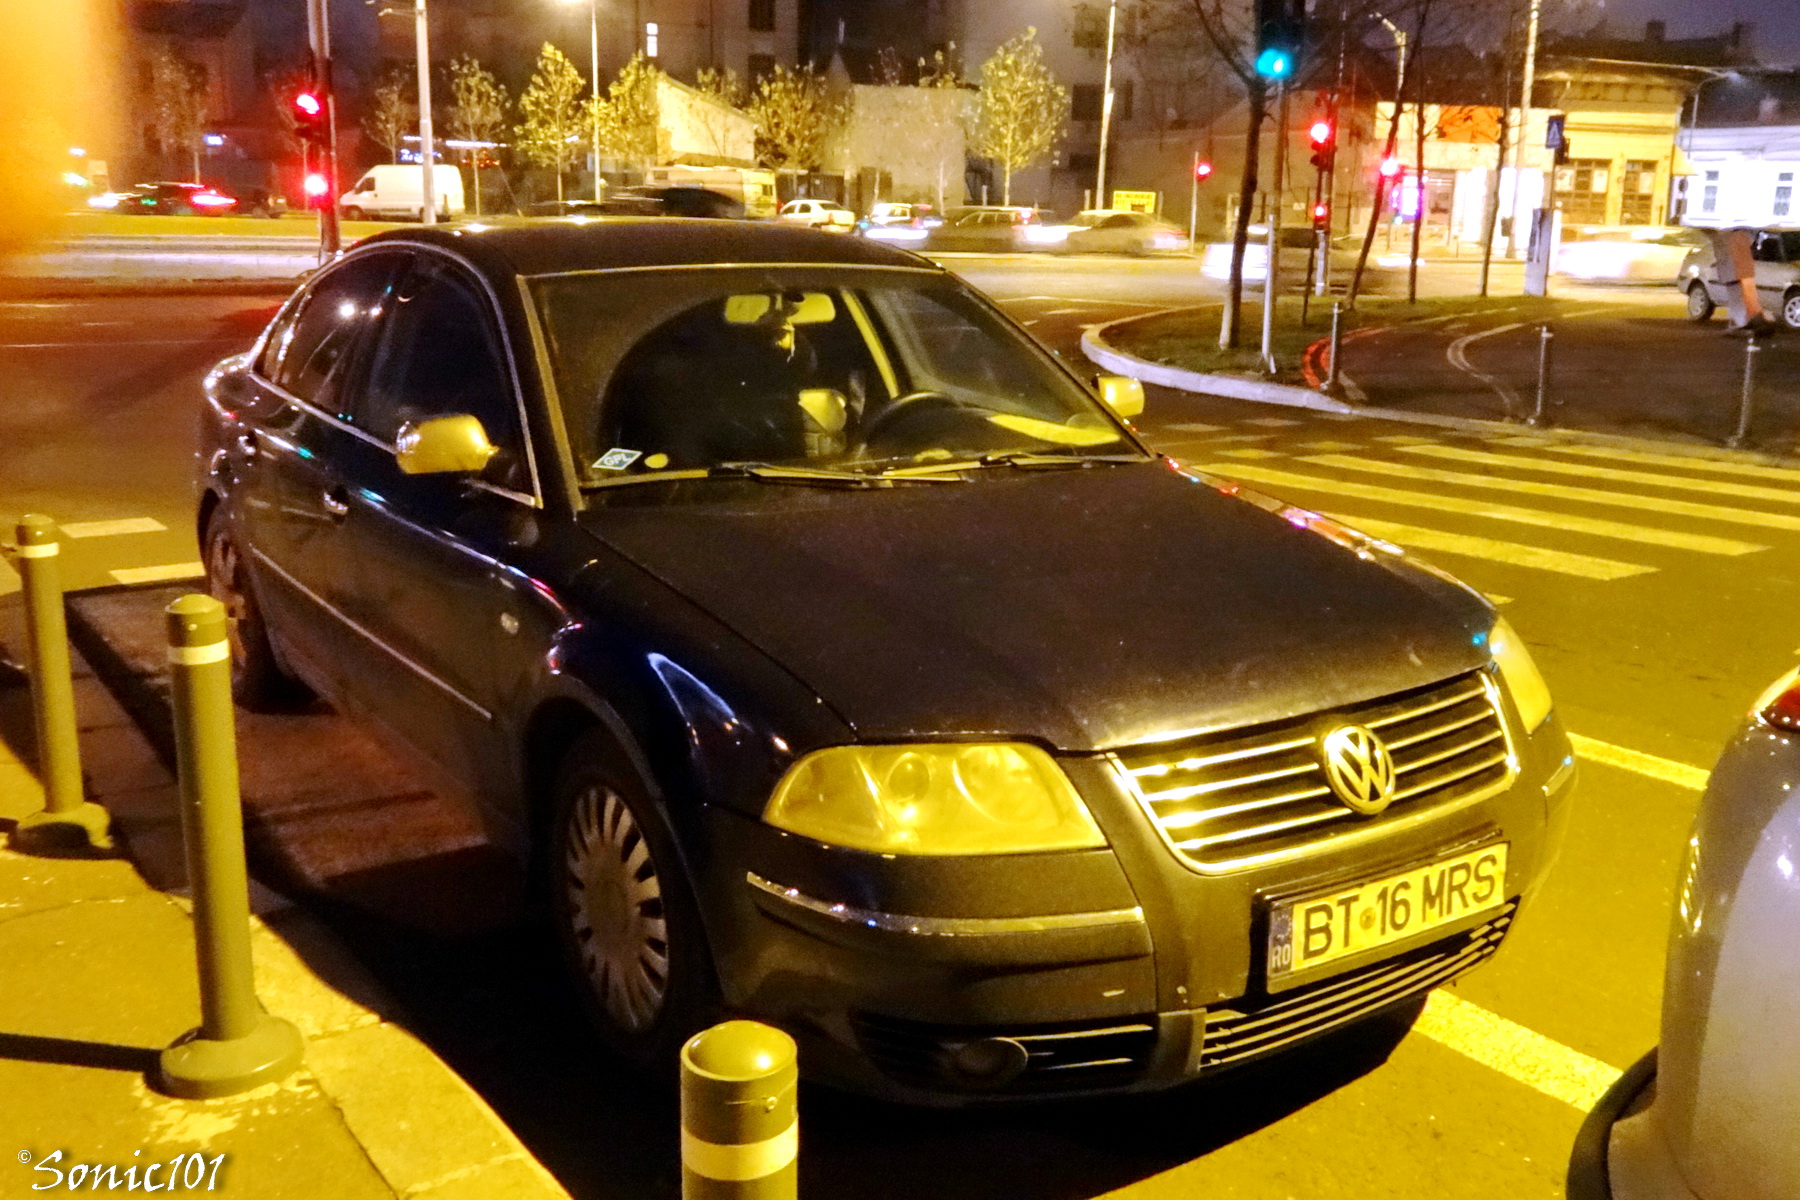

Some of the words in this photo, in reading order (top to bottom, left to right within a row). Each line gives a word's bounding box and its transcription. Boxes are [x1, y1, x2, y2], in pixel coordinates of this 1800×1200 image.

[604, 453, 631, 466] GPL
[1325, 727, 1394, 812] VW
[1303, 893, 1360, 961] BT
[1376, 880, 1412, 936] 16
[1422, 853, 1498, 923] MRS
[1272, 944, 1292, 970] RO
